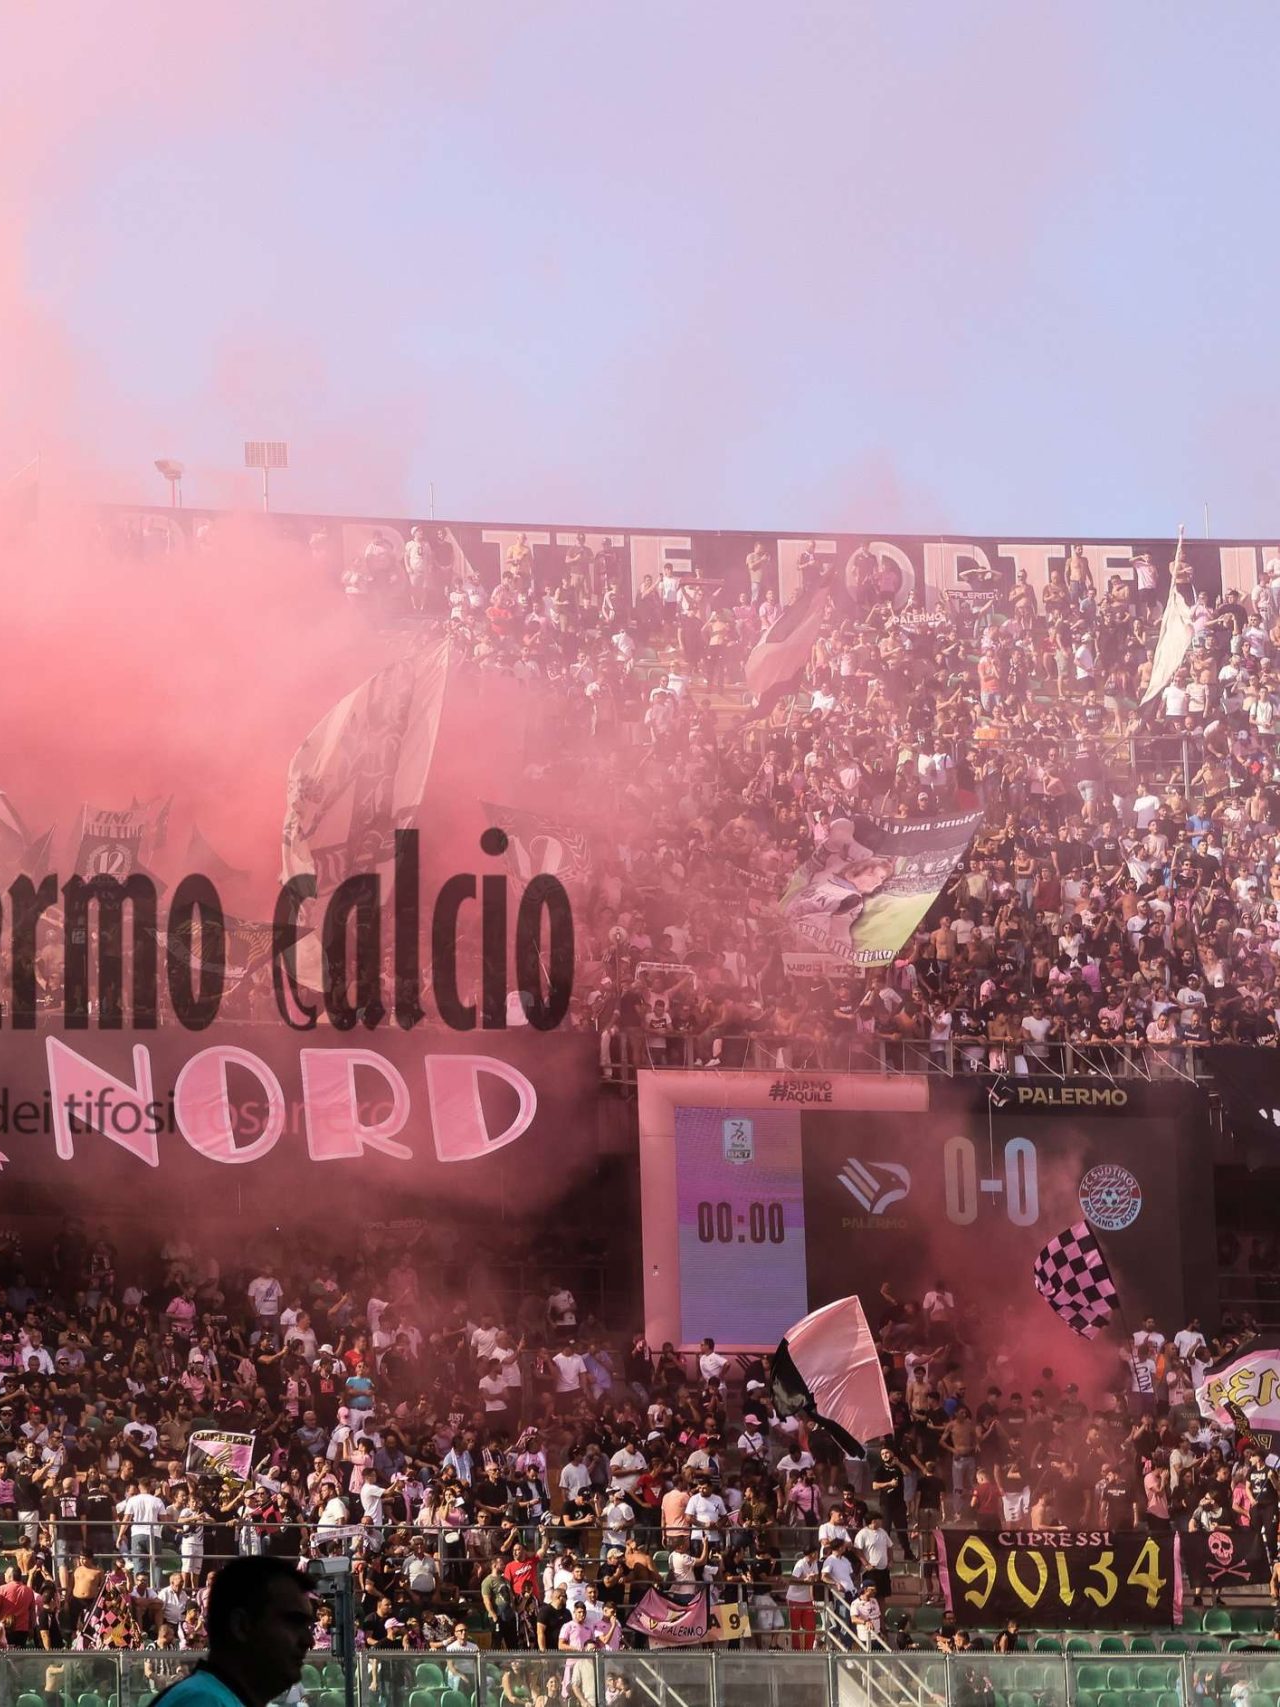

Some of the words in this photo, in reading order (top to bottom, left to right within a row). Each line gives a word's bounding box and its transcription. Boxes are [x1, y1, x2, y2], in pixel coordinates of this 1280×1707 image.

[892, 611, 944, 625] PALERMO
[45, 1036, 537, 1168] NORD
[786, 1091, 833, 1103] AQUILE
[1017, 1086, 1128, 1106] PALERMO
[697, 1201, 785, 1244] 00:00
[1081, 1199, 1115, 1229] BOLZANO
[1120, 1199, 1140, 1227] BOZEN
[841, 1217, 908, 1230] PALERMO
[998, 1531, 1113, 1548] CIPRESSI
